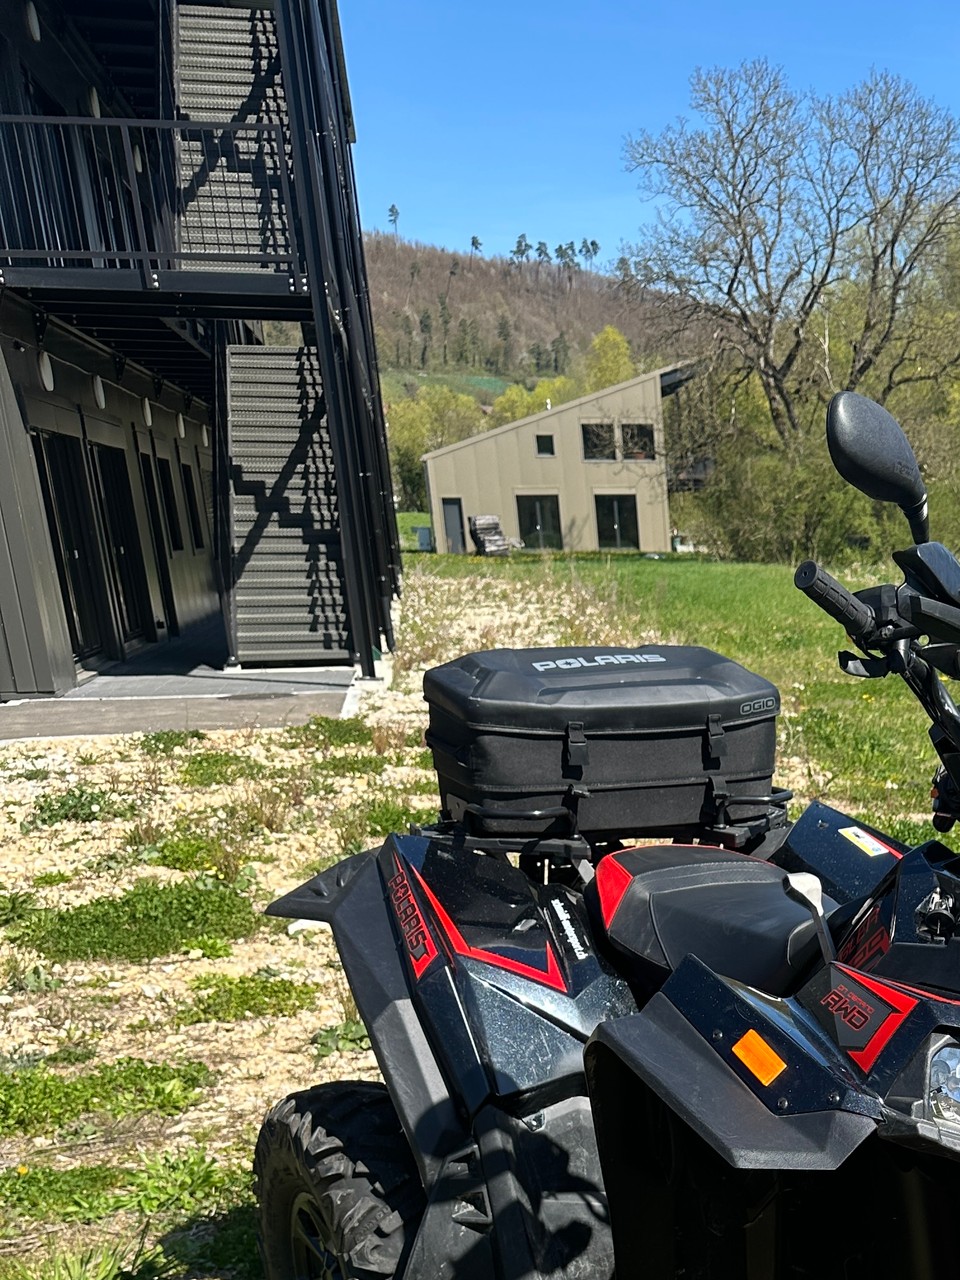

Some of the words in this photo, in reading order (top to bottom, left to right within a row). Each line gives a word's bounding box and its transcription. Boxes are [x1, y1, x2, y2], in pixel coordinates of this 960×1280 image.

[532, 654, 666, 672] POLARIS
[740, 697, 775, 715] OGIO
[388, 871, 427, 952] POLARIS
[820, 989, 870, 1031] AWD
